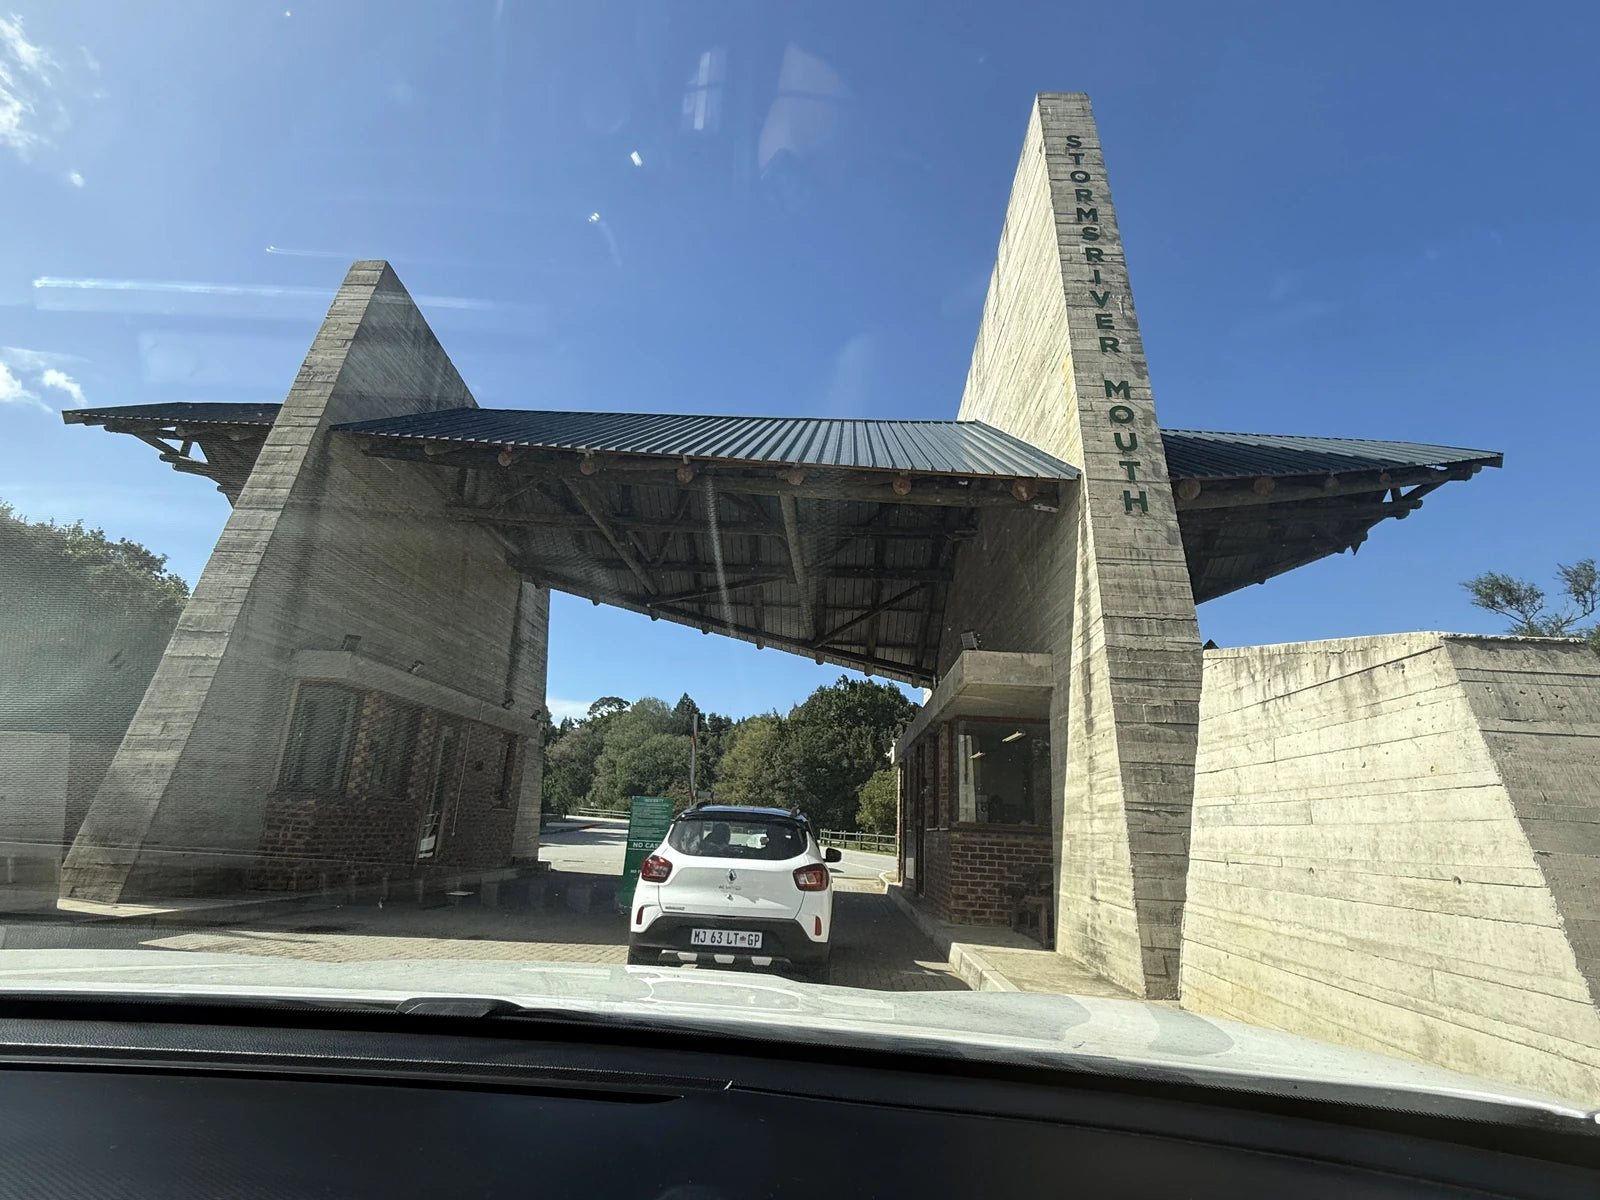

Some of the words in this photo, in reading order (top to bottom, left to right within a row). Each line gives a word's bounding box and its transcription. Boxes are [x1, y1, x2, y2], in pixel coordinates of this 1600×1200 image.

[1103, 379, 1149, 513] MOUTH
[710, 931, 723, 944] 63
[726, 932, 740, 945] LT
[747, 933, 760, 947] GP
